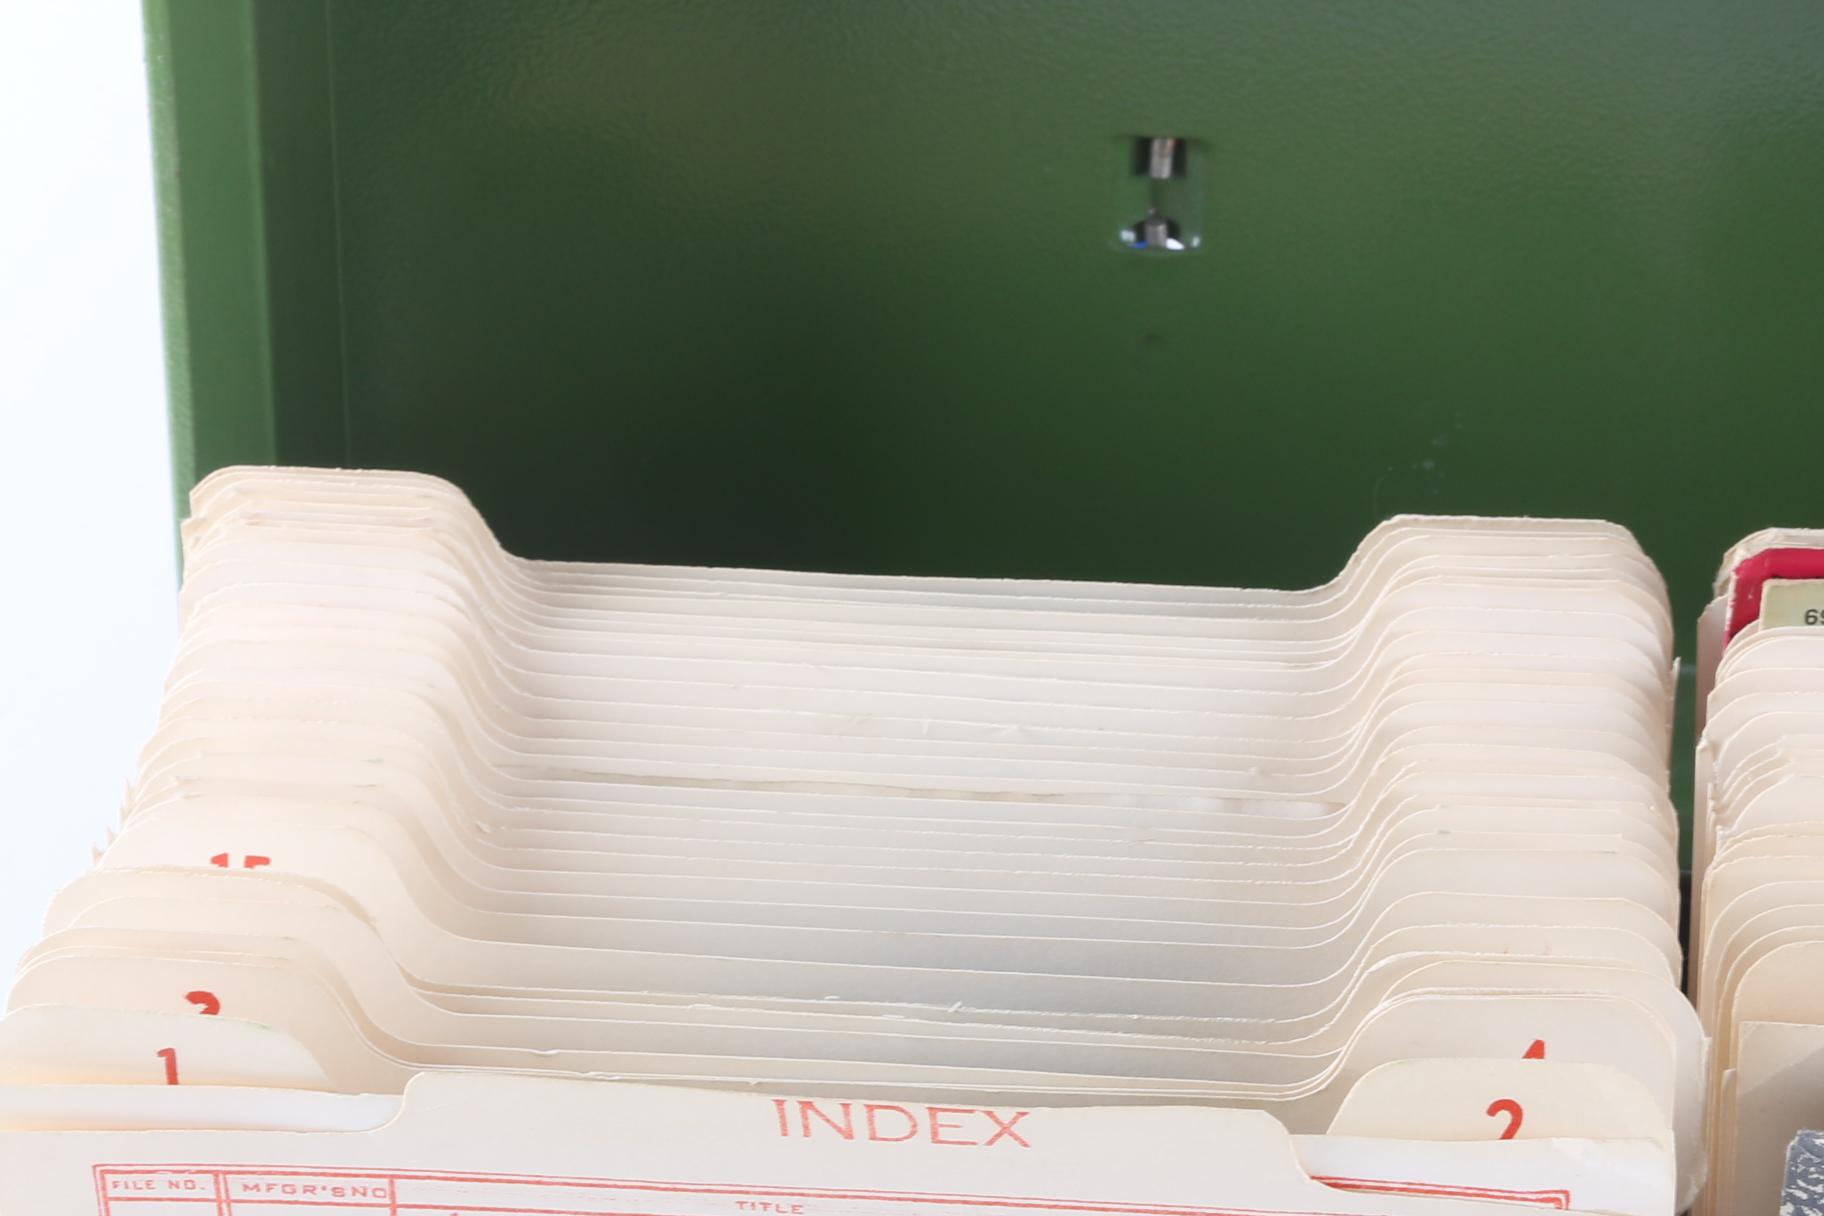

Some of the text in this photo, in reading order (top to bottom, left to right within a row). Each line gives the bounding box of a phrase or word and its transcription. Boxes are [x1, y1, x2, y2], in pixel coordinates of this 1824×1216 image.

[156, 1047, 179, 1085] 1
[772, 1098, 1032, 1149] INDEX
[1486, 1098, 1524, 1140] 2
[111, 1179, 206, 1191] FILE NO.
[735, 1200, 804, 1215] TITLE
